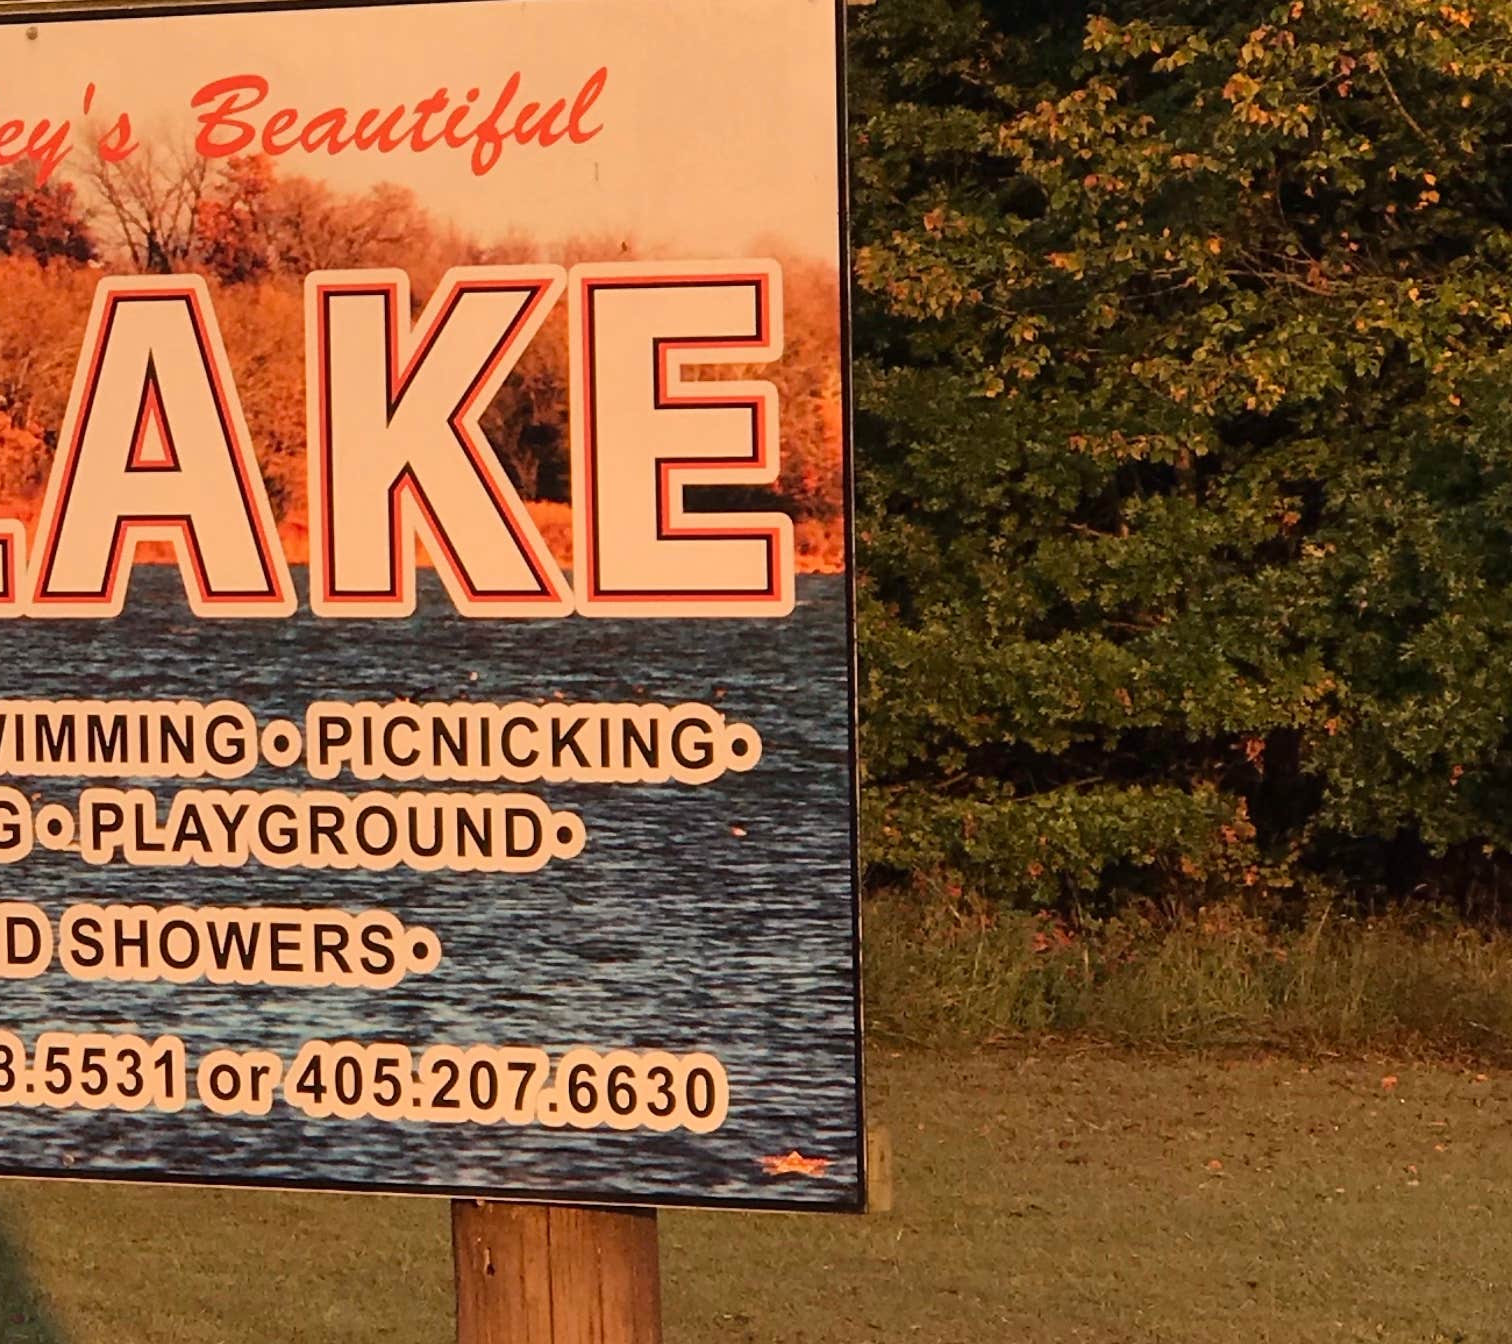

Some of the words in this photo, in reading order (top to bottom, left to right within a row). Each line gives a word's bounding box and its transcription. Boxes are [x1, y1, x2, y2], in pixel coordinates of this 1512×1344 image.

[192, 67, 606, 175] Beautiful
[320, 716, 713, 769] PICNICKING
[92, 803, 542, 857] PLAYGROUND
[71, 918, 394, 974] SHOWERS
[210, 1065, 269, 1100] or
[296, 1054, 715, 1118] 405.207.6630
